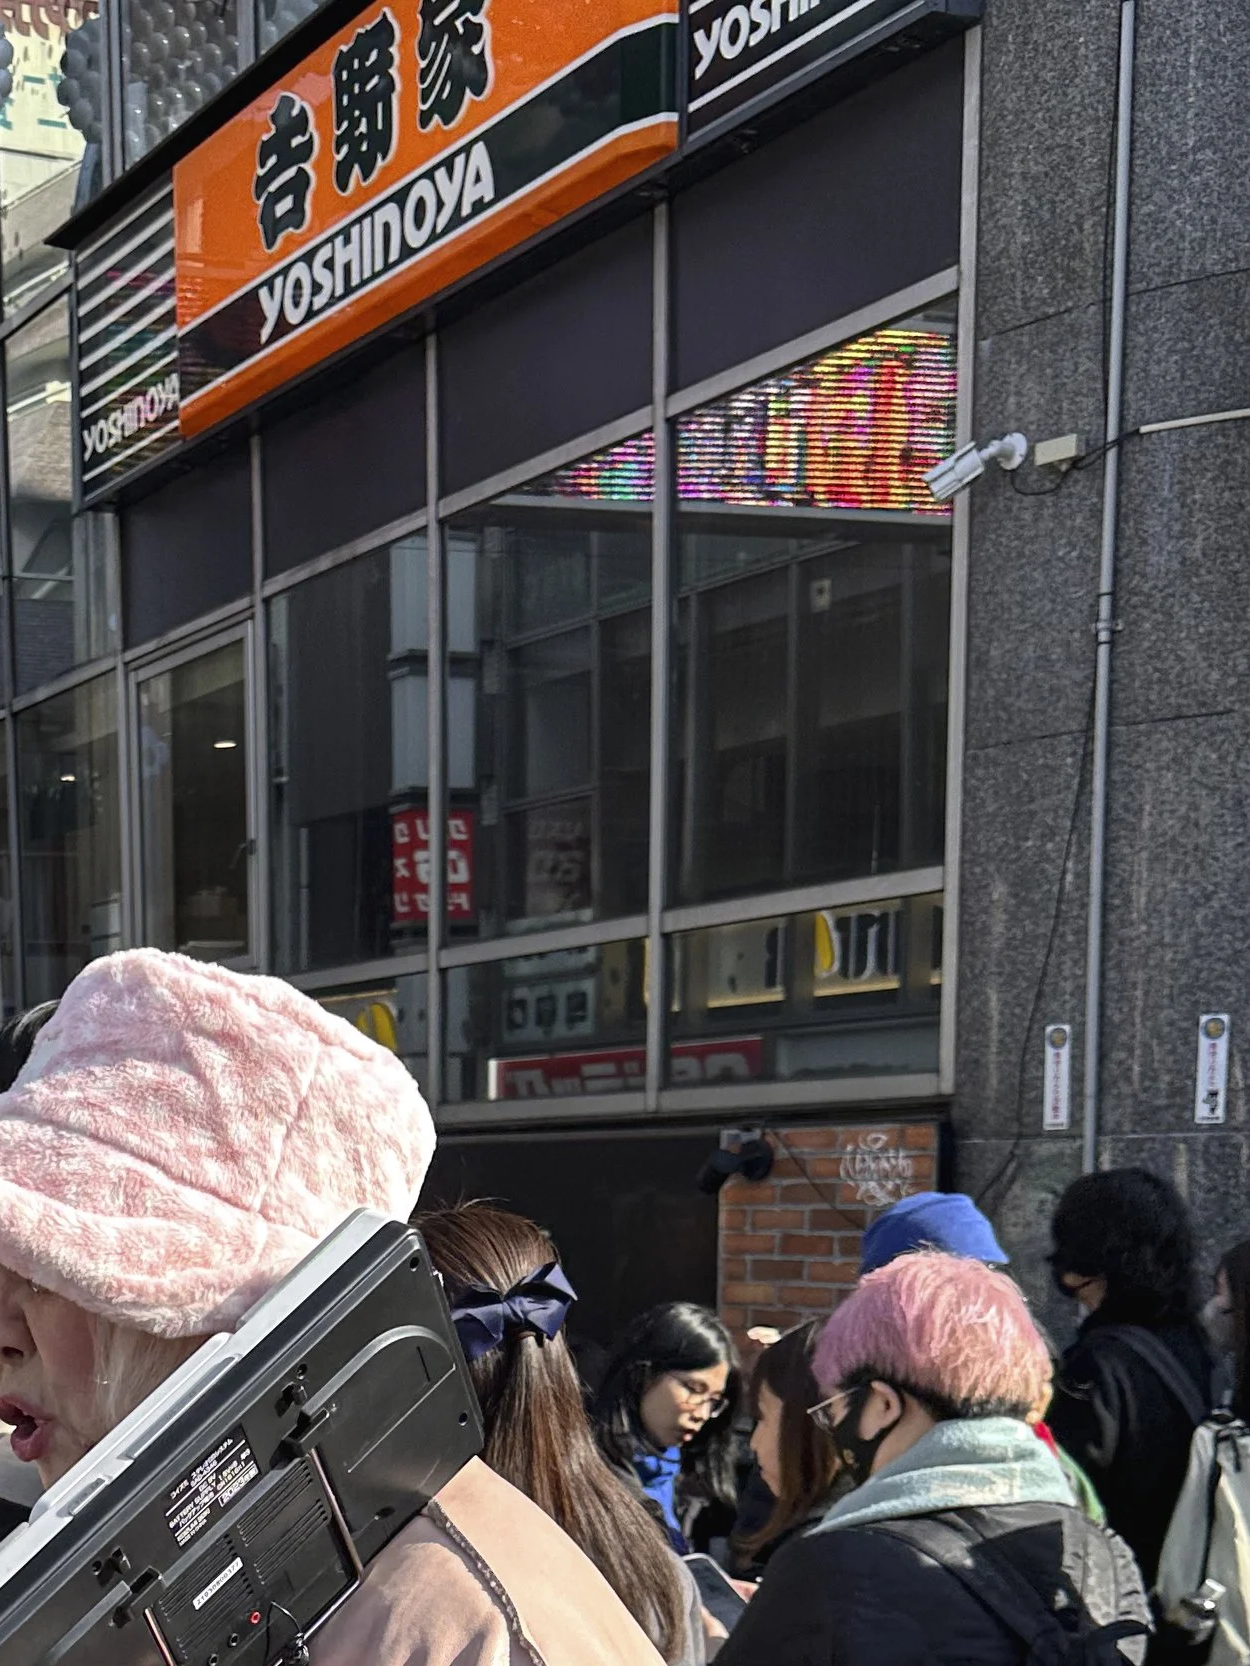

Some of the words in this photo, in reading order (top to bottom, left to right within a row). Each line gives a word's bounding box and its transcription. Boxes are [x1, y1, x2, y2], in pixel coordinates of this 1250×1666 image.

[253, 0, 495, 252] 吉野家
[258, 141, 495, 345] YOSHINOYA
[82, 373, 180, 461] YOSHINOYA
